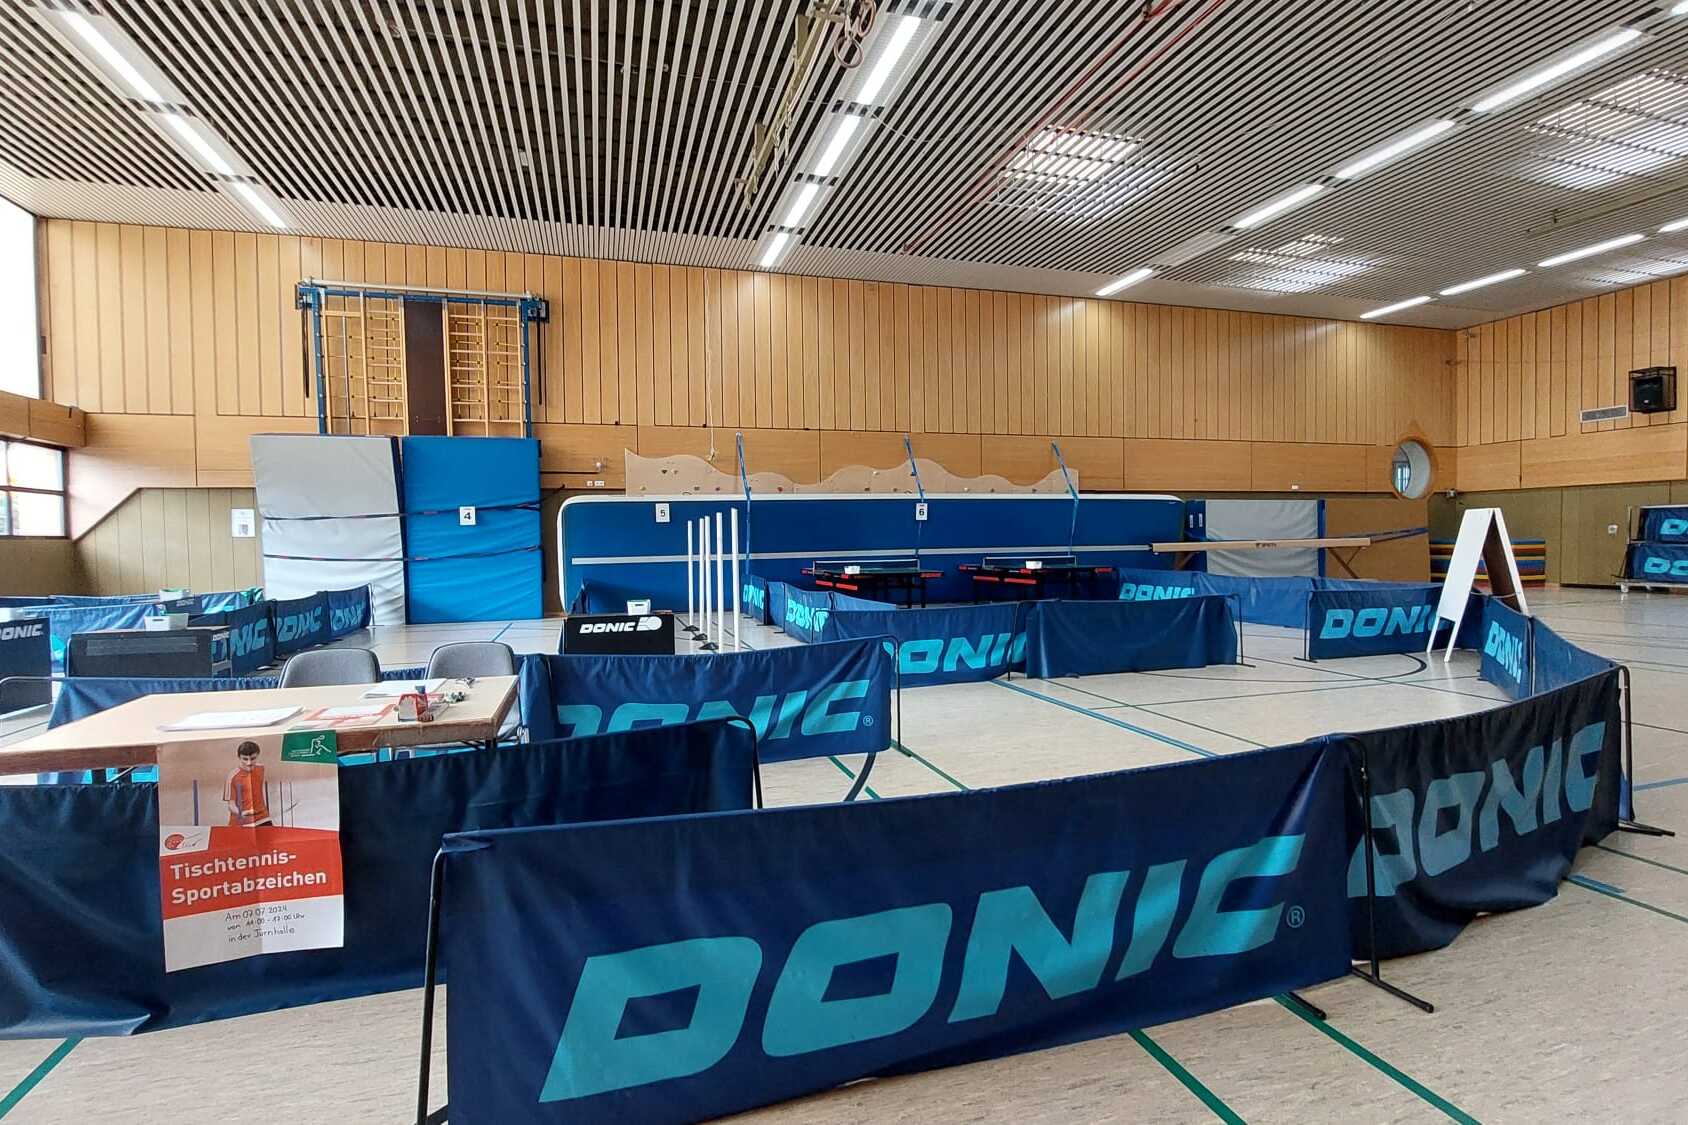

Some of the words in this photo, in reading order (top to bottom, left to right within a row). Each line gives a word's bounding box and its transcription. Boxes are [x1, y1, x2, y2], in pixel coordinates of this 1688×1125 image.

[463, 511, 472, 520] 4
[0, 623, 43, 641] ONIC
[579, 622, 636, 634] DONIC
[882, 632, 1027, 675] ONI
[1346, 720, 1606, 898] DONIC
[170, 850, 297, 881] Tischtennis-
[171, 871, 327, 905] Sportabzeichen
[538, 833, 1306, 1103] DONIC
